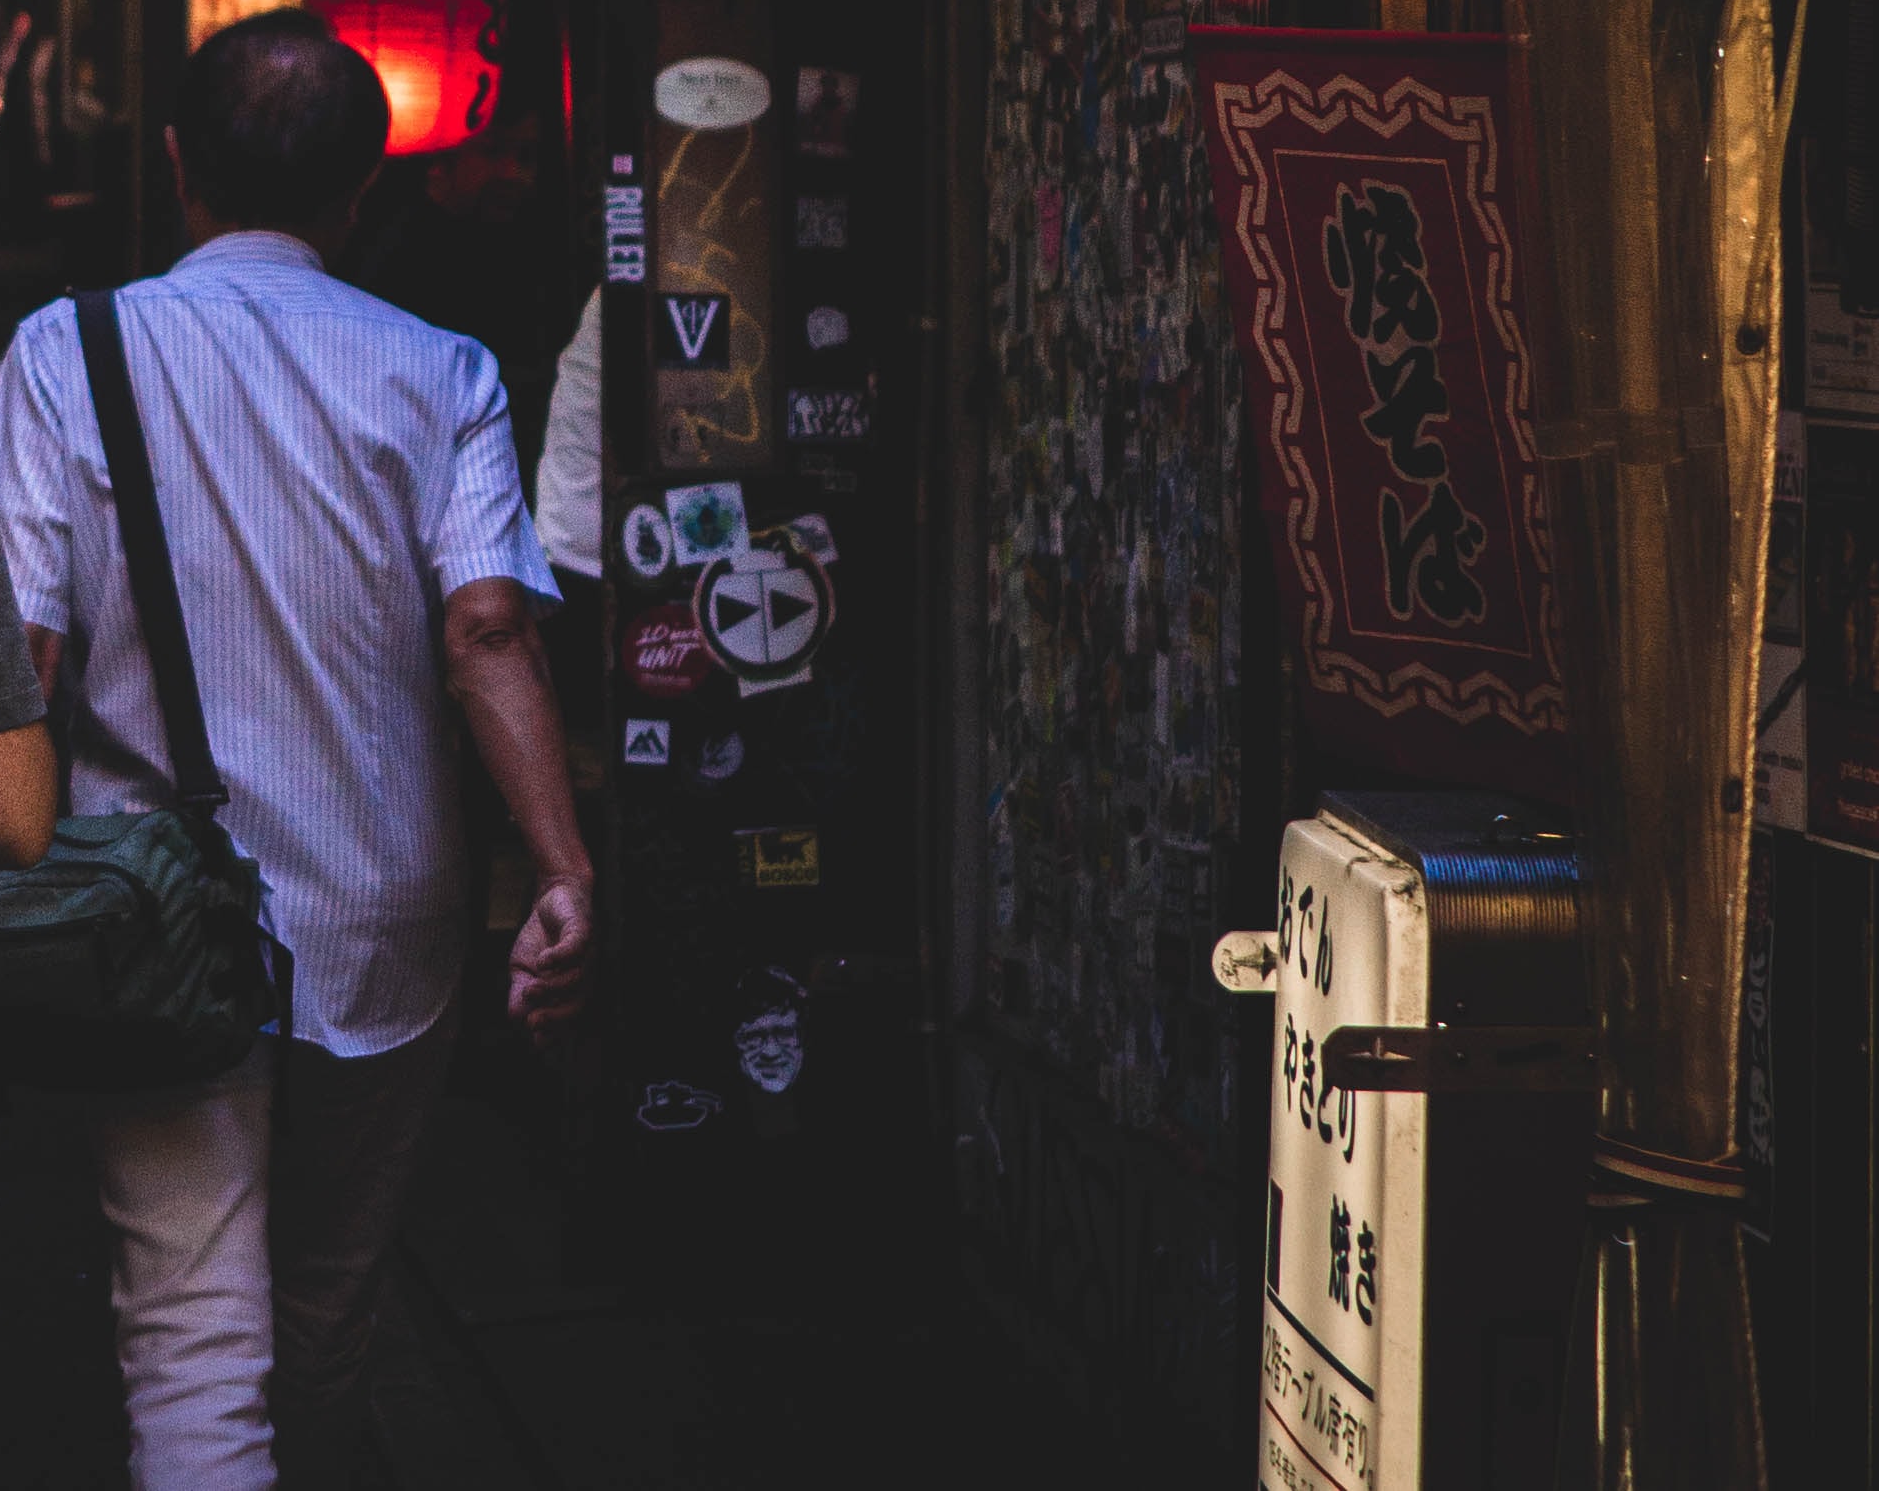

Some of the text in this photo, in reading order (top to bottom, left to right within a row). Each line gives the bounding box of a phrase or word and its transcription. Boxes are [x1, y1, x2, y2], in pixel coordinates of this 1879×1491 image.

[603, 184, 647, 284] RULER
[1279, 865, 1334, 998] おでん
